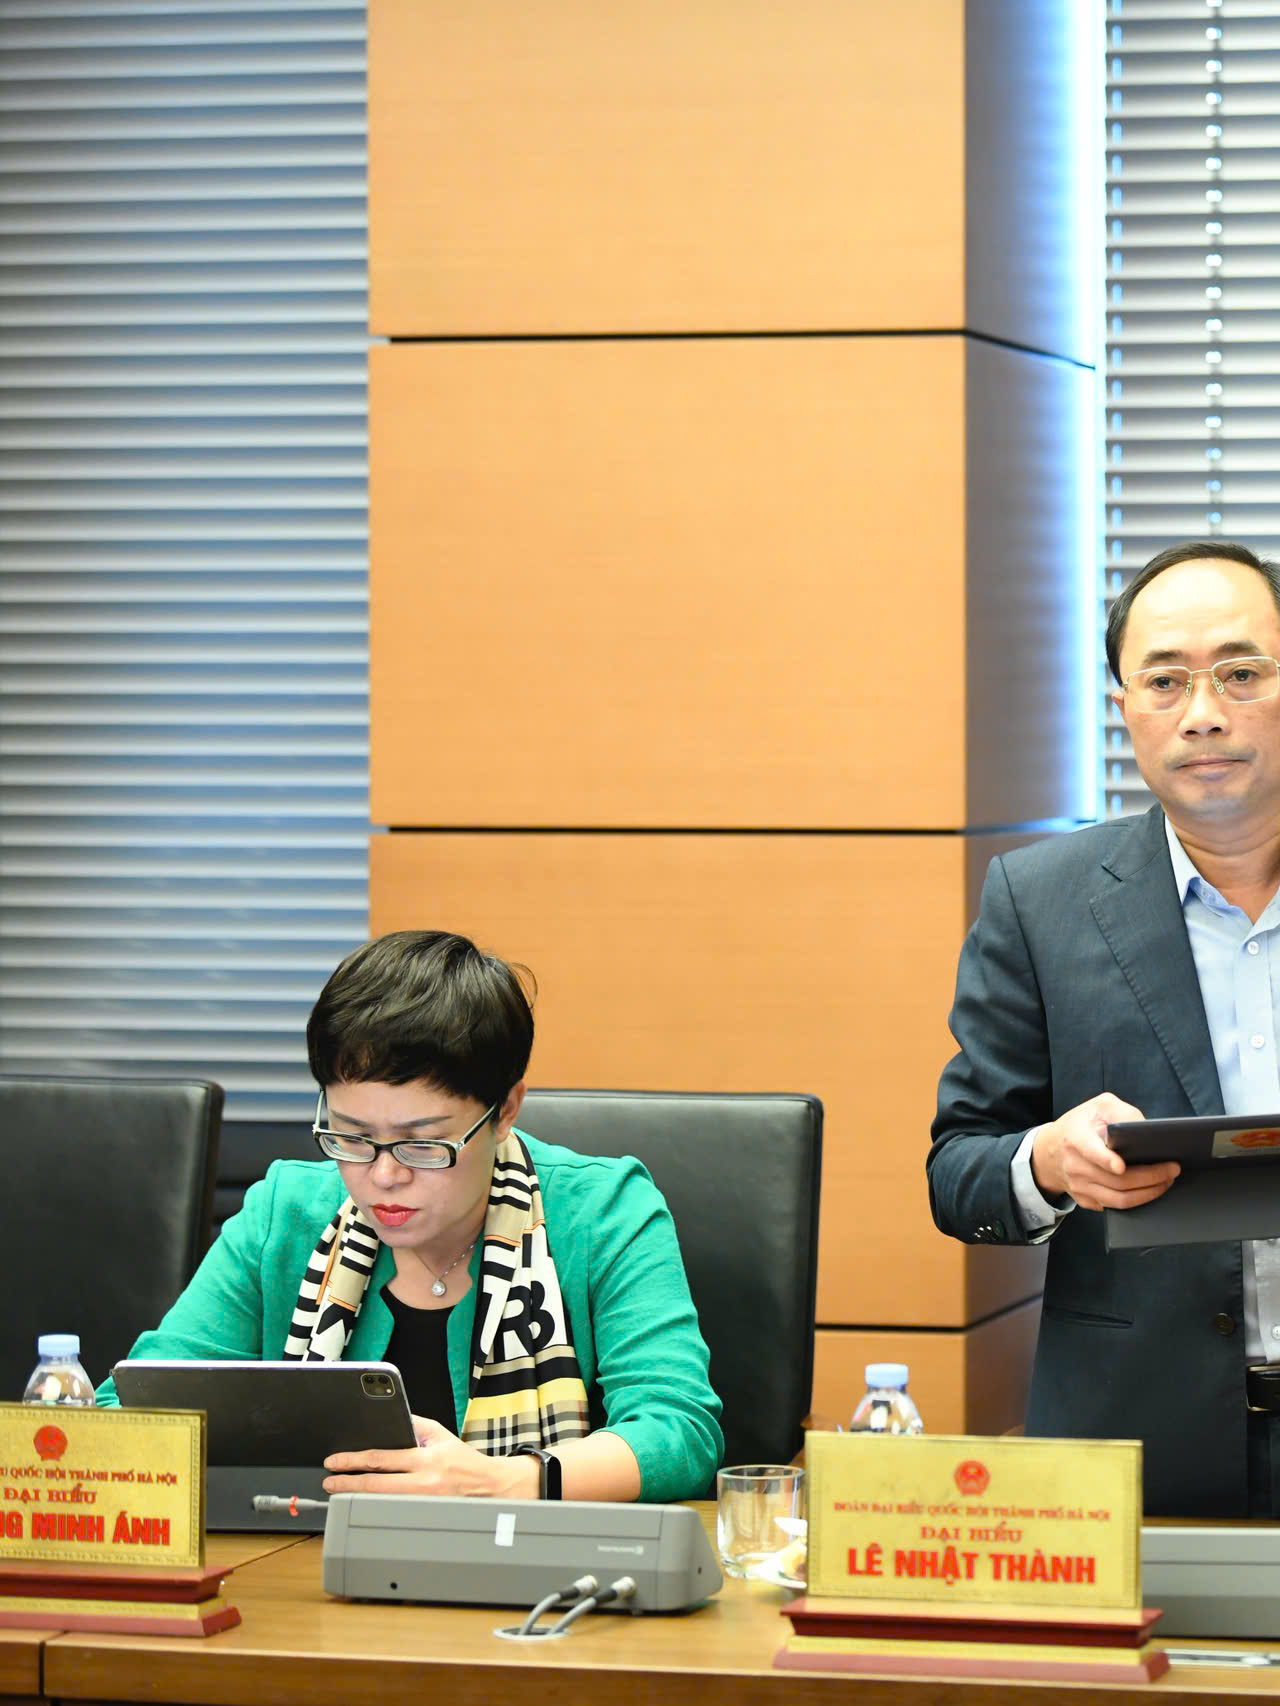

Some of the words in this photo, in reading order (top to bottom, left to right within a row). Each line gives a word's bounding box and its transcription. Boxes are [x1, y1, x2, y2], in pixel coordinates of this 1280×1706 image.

[3, 1487, 41, 1503] ĐẠI
[47, 1483, 97, 1504] BIỂU
[32, 1512, 105, 1543] MINH
[969, 1520, 1023, 1543] BIỂU
[847, 1542, 883, 1576] LÊ
[894, 1545, 979, 1586] NHẬT
[988, 1548, 1096, 1584] THÀNH
